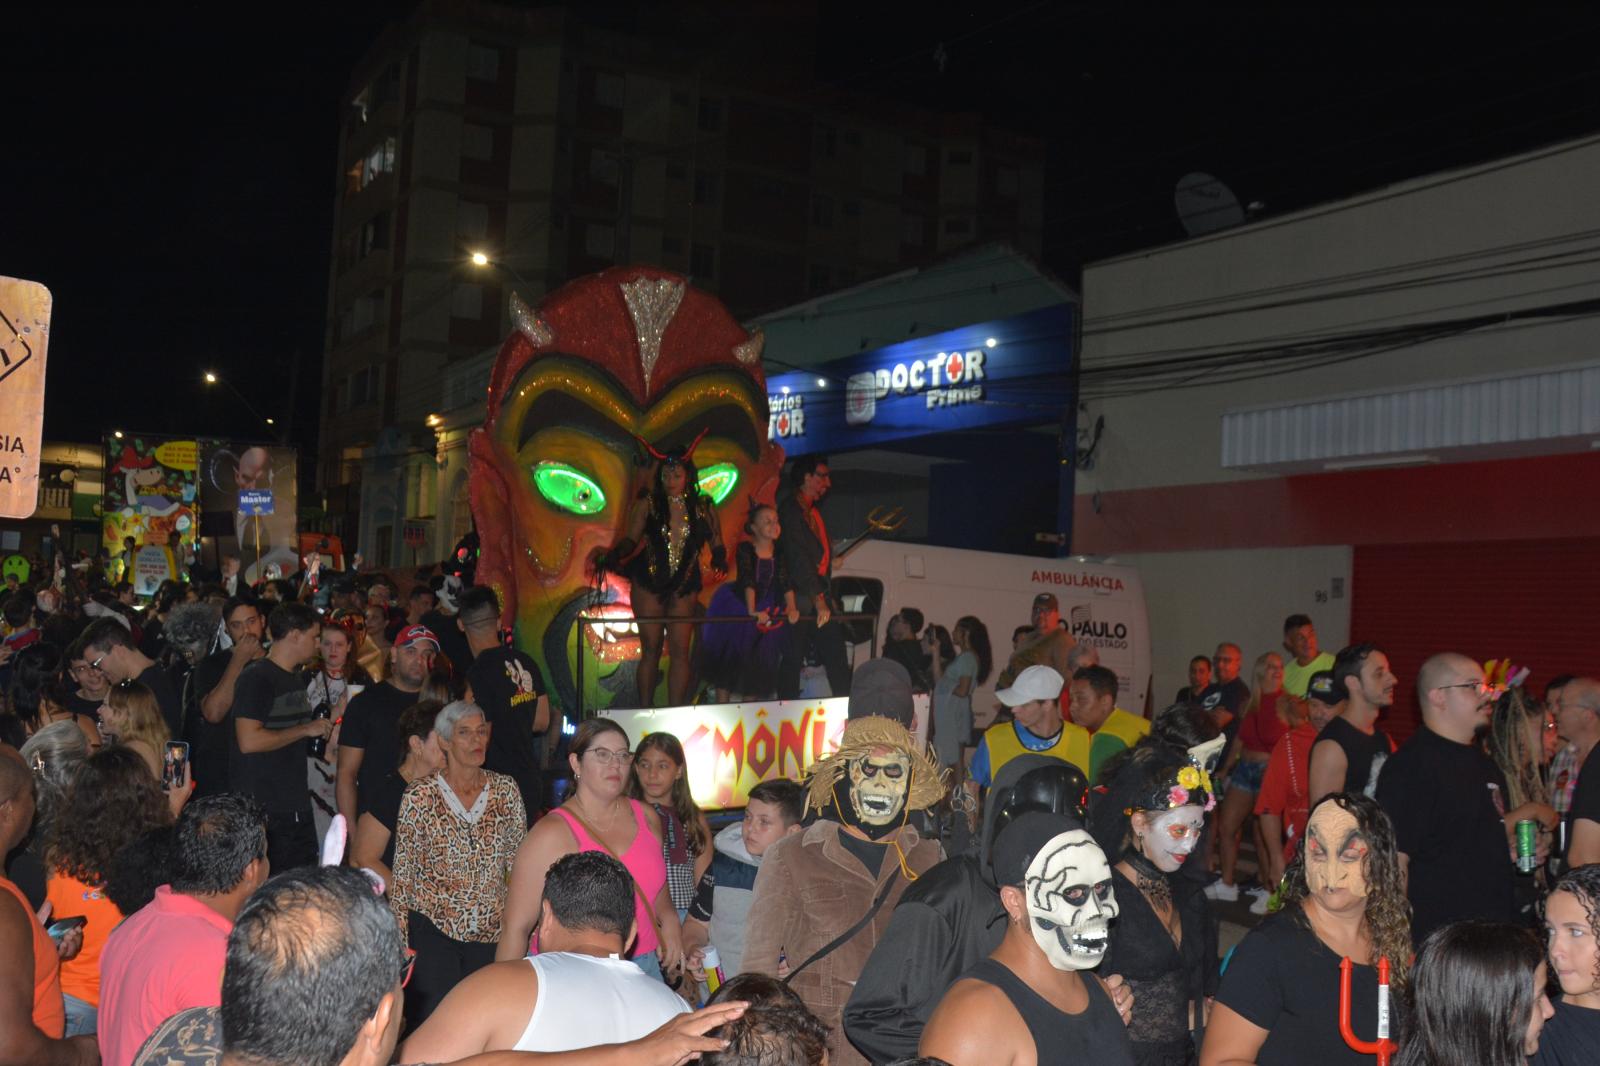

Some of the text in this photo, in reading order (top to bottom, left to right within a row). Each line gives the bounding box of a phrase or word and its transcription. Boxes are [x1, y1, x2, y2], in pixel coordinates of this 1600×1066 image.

[875, 351, 984, 399] DOCTOR
[926, 385, 983, 409] Prime
[1031, 570, 1124, 592] AMBULÂNCIA
[1072, 620, 1127, 640] PAULO
[1093, 639, 1128, 650] ESTADO
